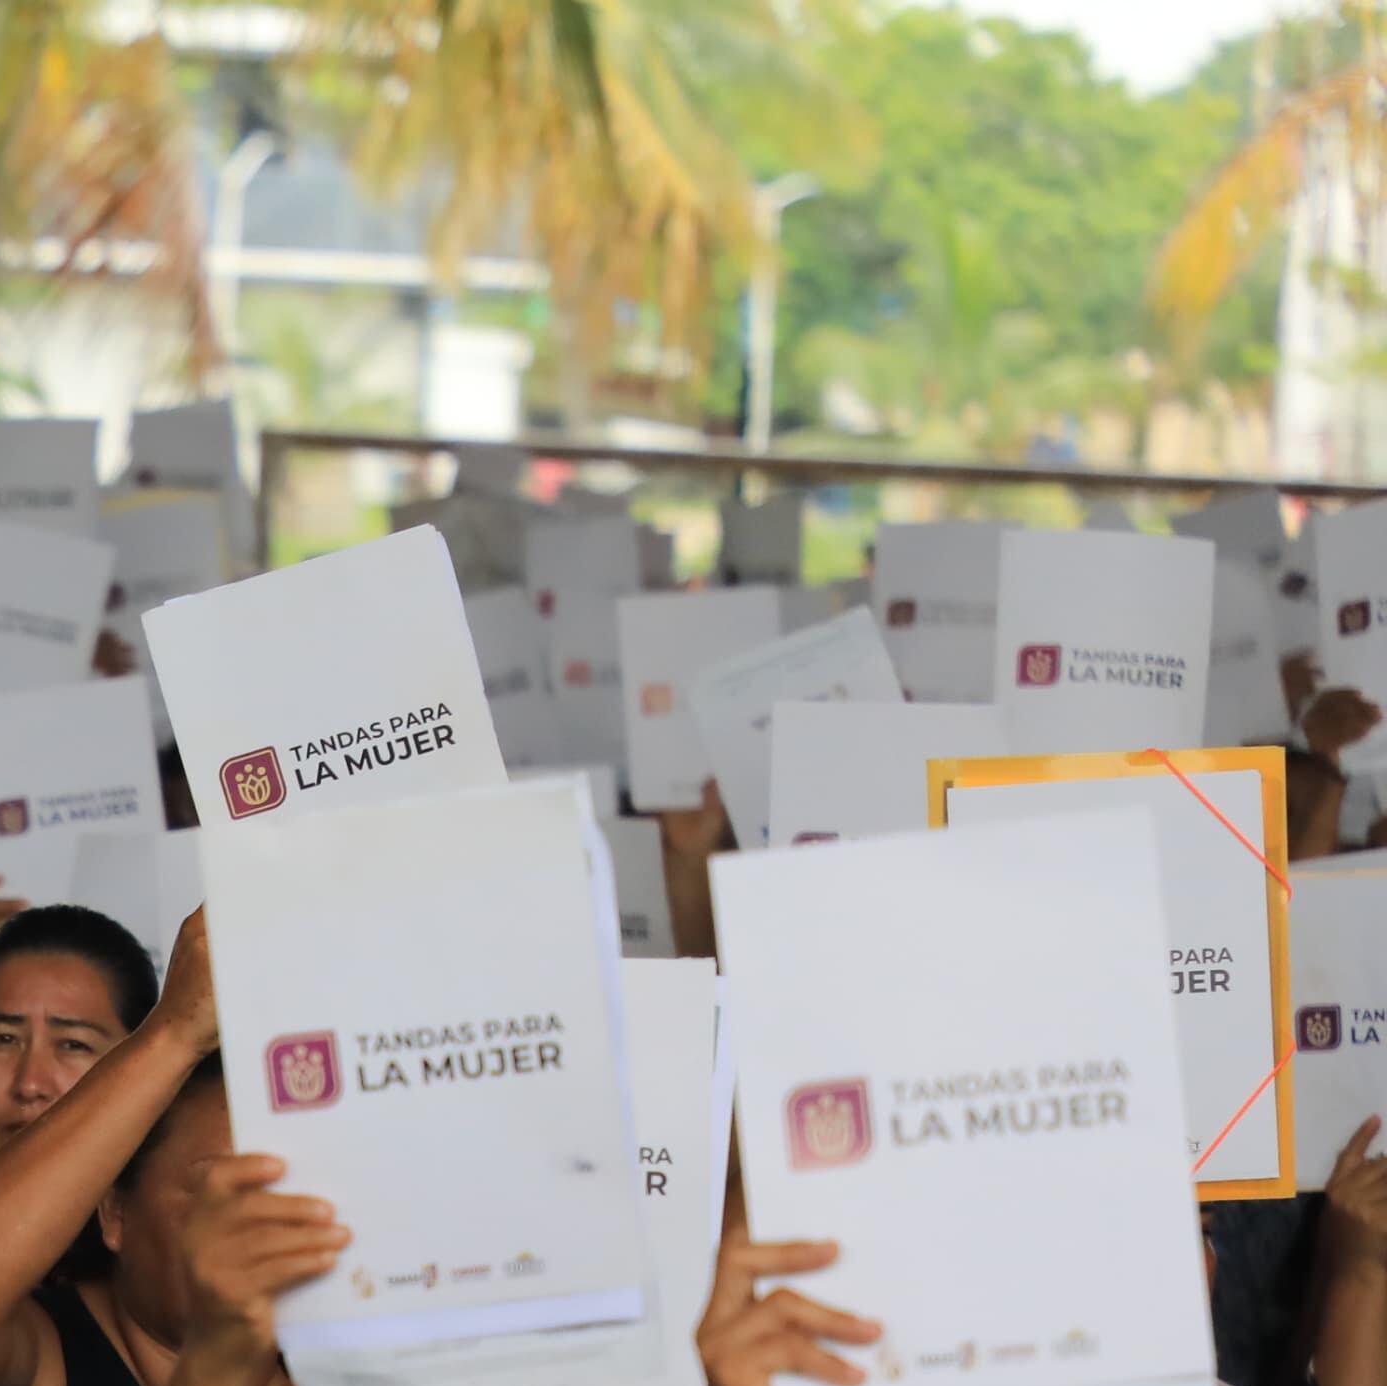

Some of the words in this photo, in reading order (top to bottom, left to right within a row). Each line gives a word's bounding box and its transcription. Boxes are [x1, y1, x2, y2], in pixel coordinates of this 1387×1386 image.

[1068, 665, 1099, 682] LA
[1106, 668, 1184, 688] MUJER
[289, 722, 385, 762] TANDAS
[388, 702, 452, 733] PARA
[294, 760, 339, 790] LA
[344, 724, 455, 775] MUJER
[1170, 947, 1234, 966] PARA
[1170, 969, 1232, 994] JER
[1351, 1009, 1386, 1021] TAN
[355, 1022, 475, 1056] TANDAS
[483, 1013, 564, 1042] PARA
[1351, 1026, 1380, 1044] LA
[357, 1059, 410, 1092] LA
[422, 1042, 564, 1084] MUJER
[891, 1067, 1029, 1102] TANDAS
[1037, 1057, 1129, 1083] PARA
[890, 1108, 951, 1146] LA
[966, 1091, 1128, 1138] MUJER
[638, 1146, 673, 1165] RA
